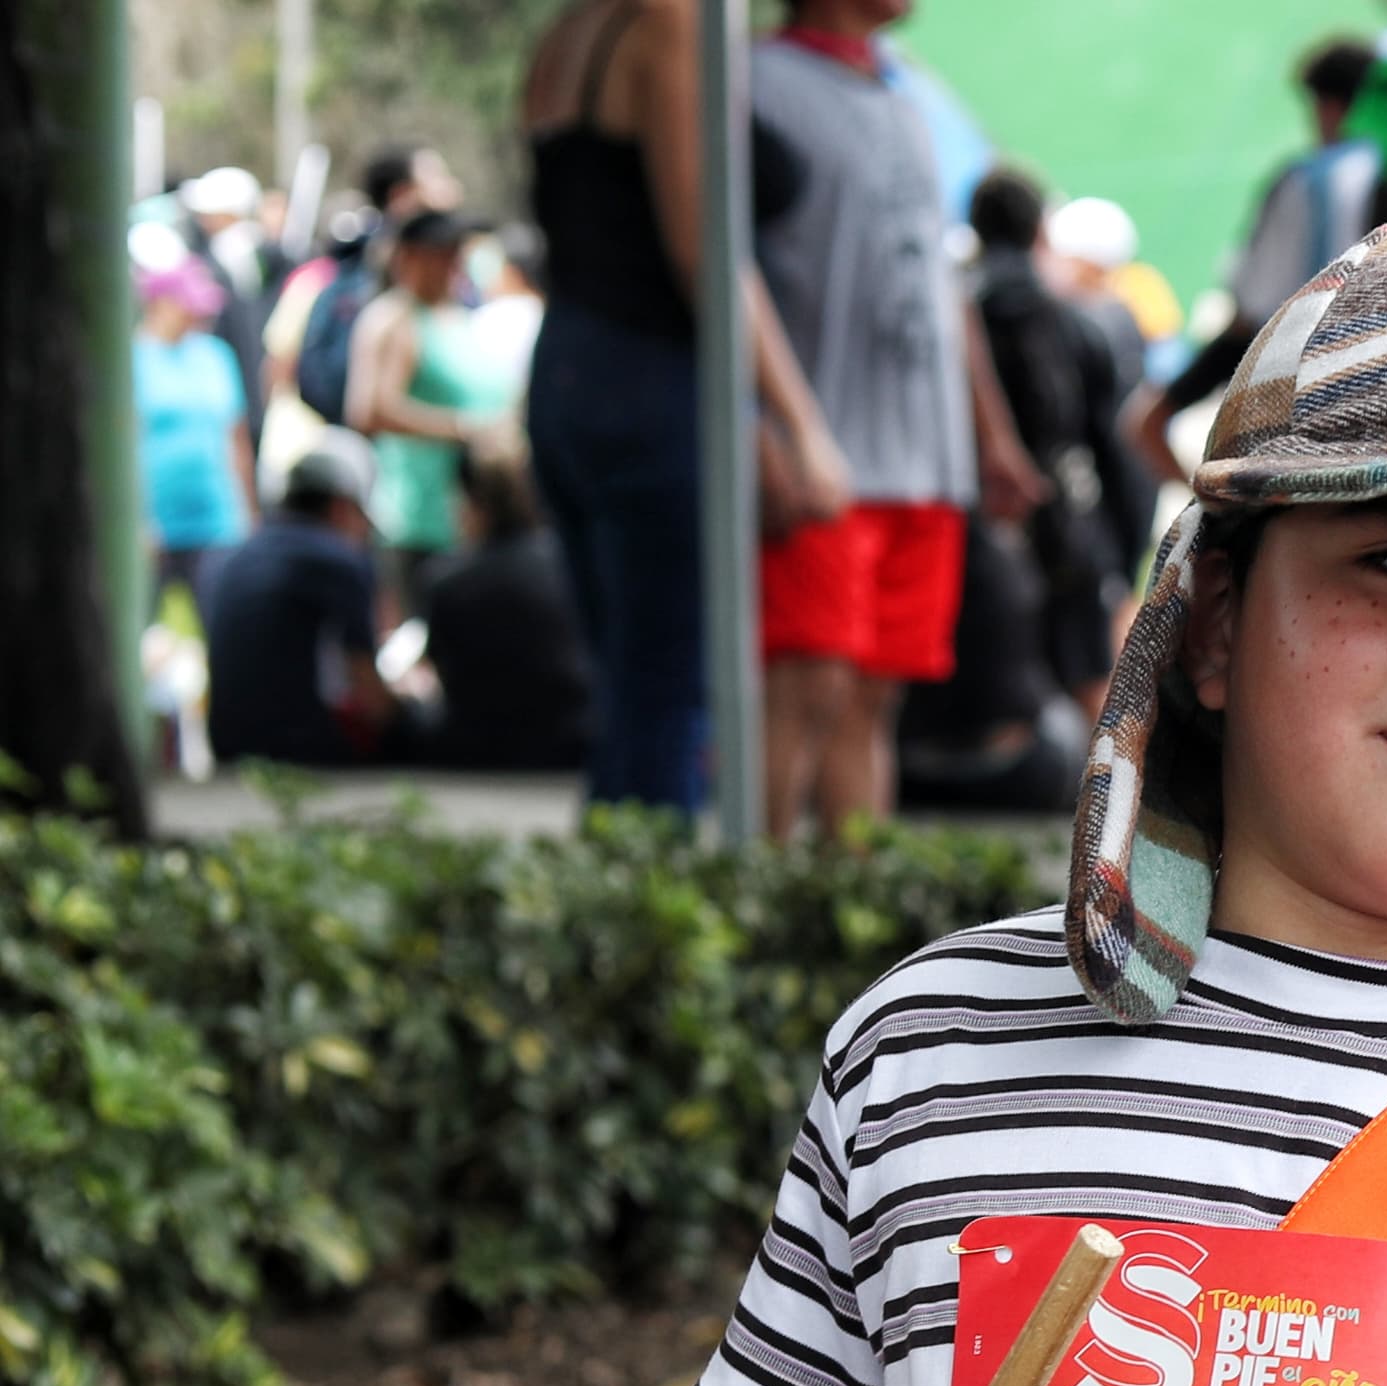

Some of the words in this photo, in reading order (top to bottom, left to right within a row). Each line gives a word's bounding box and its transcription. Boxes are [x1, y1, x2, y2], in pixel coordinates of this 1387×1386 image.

[1323, 1304, 1361, 1325] con
[1216, 1308, 1336, 1362] BUEN
[1281, 1365, 1303, 1383] el
